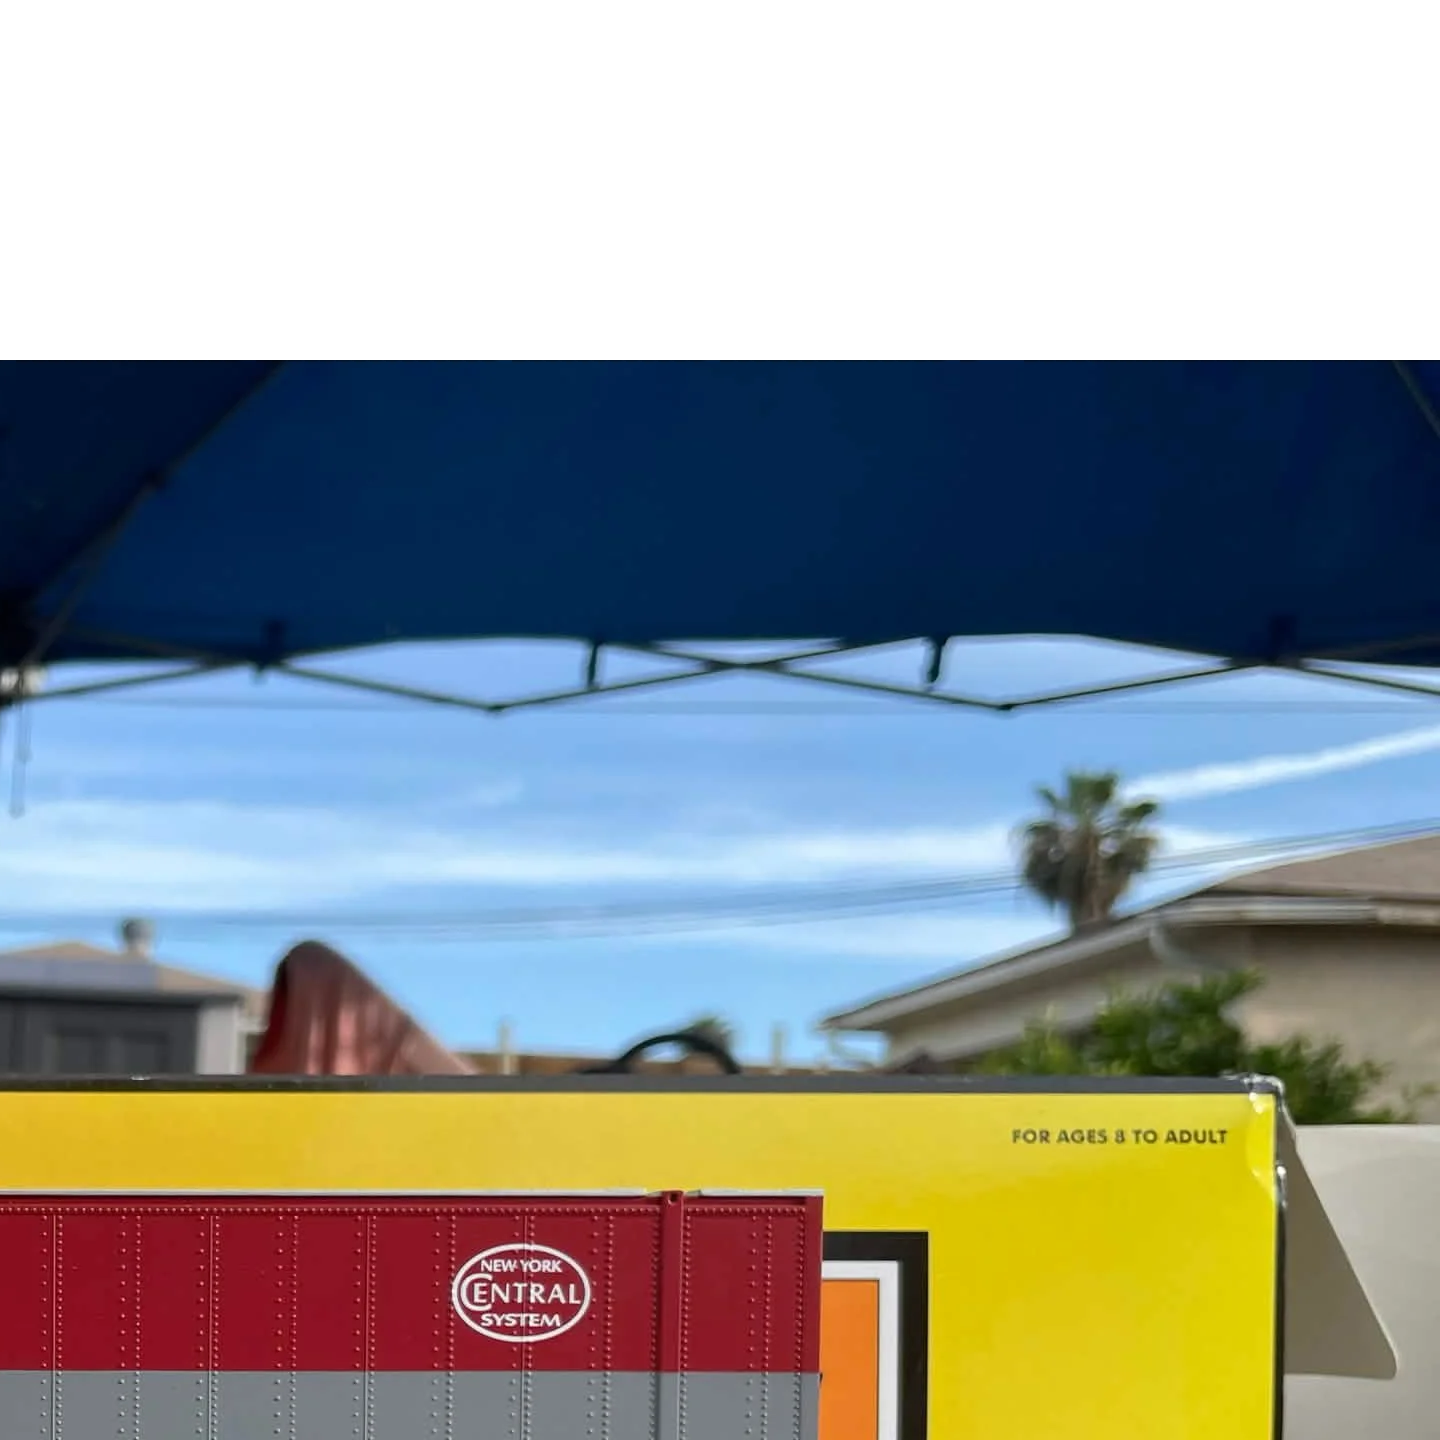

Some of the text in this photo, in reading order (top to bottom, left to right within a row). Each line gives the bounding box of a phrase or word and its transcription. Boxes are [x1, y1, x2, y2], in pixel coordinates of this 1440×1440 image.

[1012, 1129, 1228, 1145] FOR AGES 8 TO ADULT
[480, 1259, 563, 1273] NEW YORK
[460, 1273, 581, 1312] CENTRAL
[480, 1313, 561, 1327] SYSTEM
